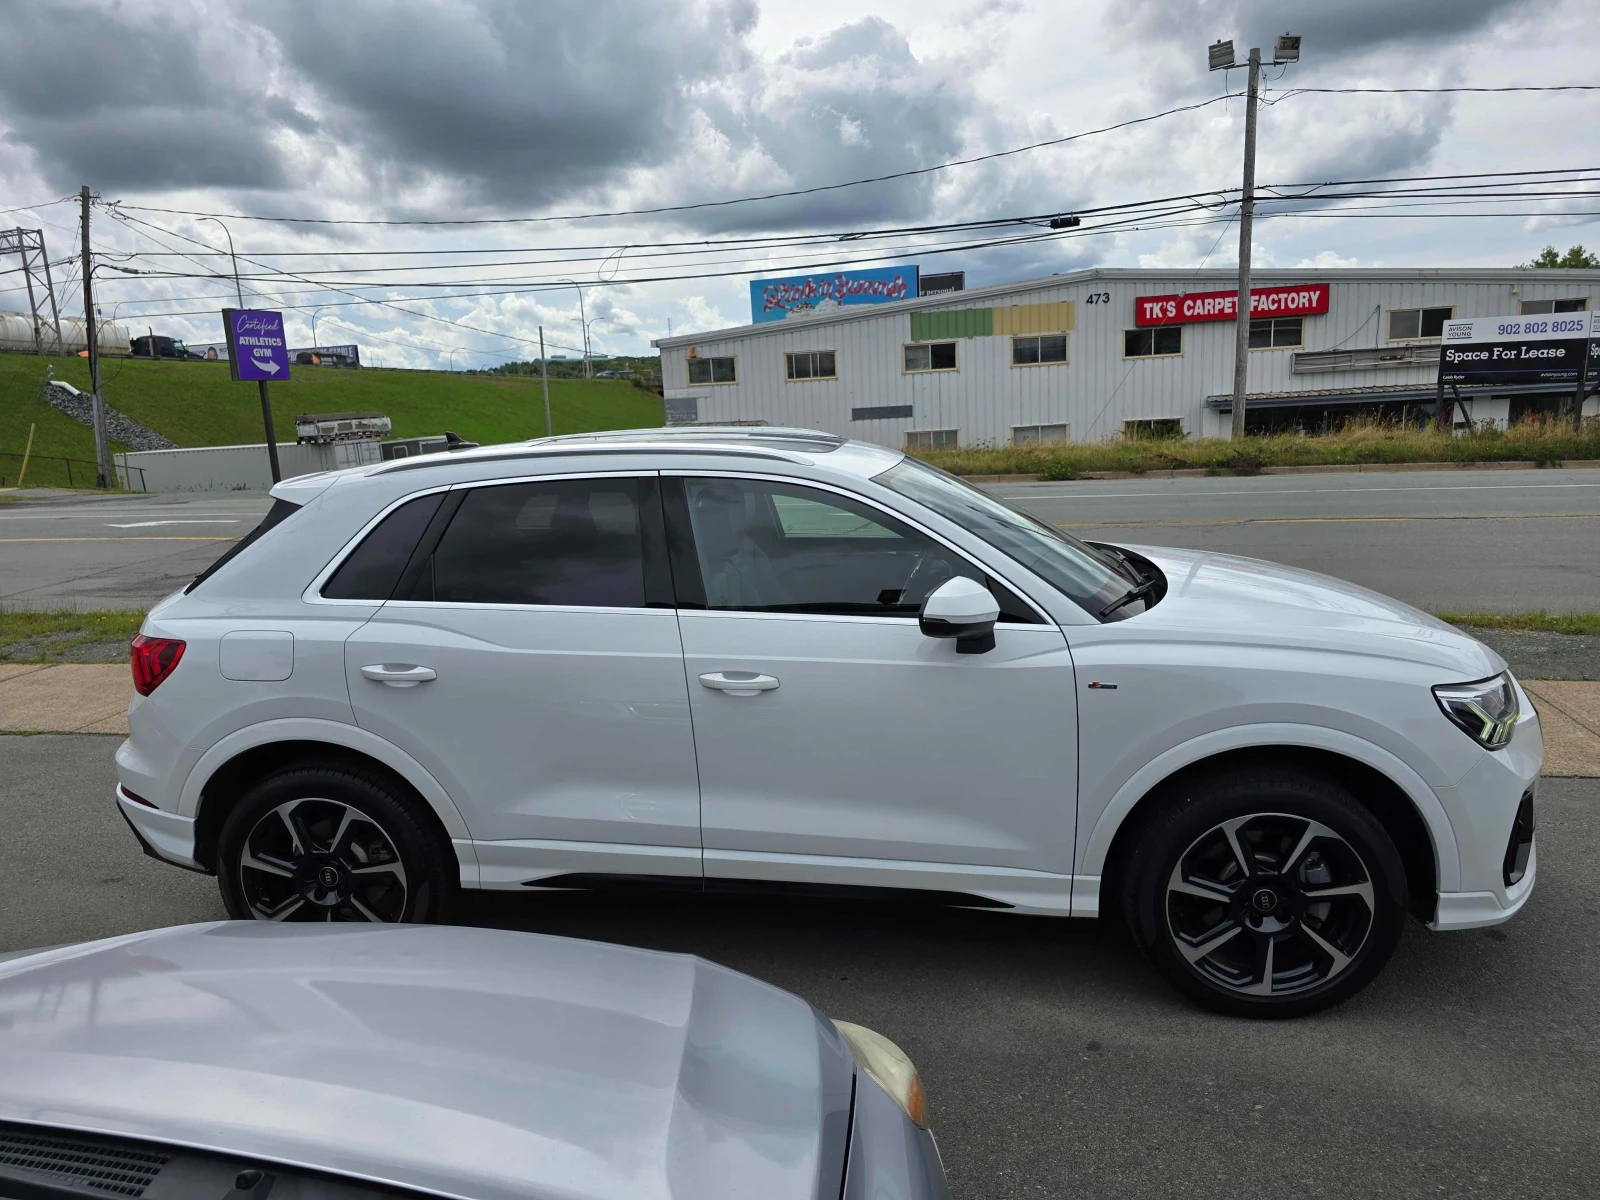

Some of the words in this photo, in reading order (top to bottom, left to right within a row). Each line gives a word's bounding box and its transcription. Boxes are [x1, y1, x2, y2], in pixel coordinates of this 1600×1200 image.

[819, 278, 833, 300] in
[834, 273, 908, 306] Summer
[1085, 292, 1111, 305] 473
[1143, 300, 1177, 319] TK'S
[1183, 296, 1239, 317] CARPET
[1249, 290, 1321, 312] FACTORY
[236, 314, 280, 335] Certified
[1498, 323, 1521, 336] 902
[1524, 321, 1548, 334] 802
[1551, 319, 1584, 333] 8025
[239, 336, 282, 346] ATHLETICS
[253, 348, 273, 357] GYM
[1445, 349, 1489, 364] Space
[1492, 347, 1518, 360] For
[1520, 346, 1566, 359] Lease
